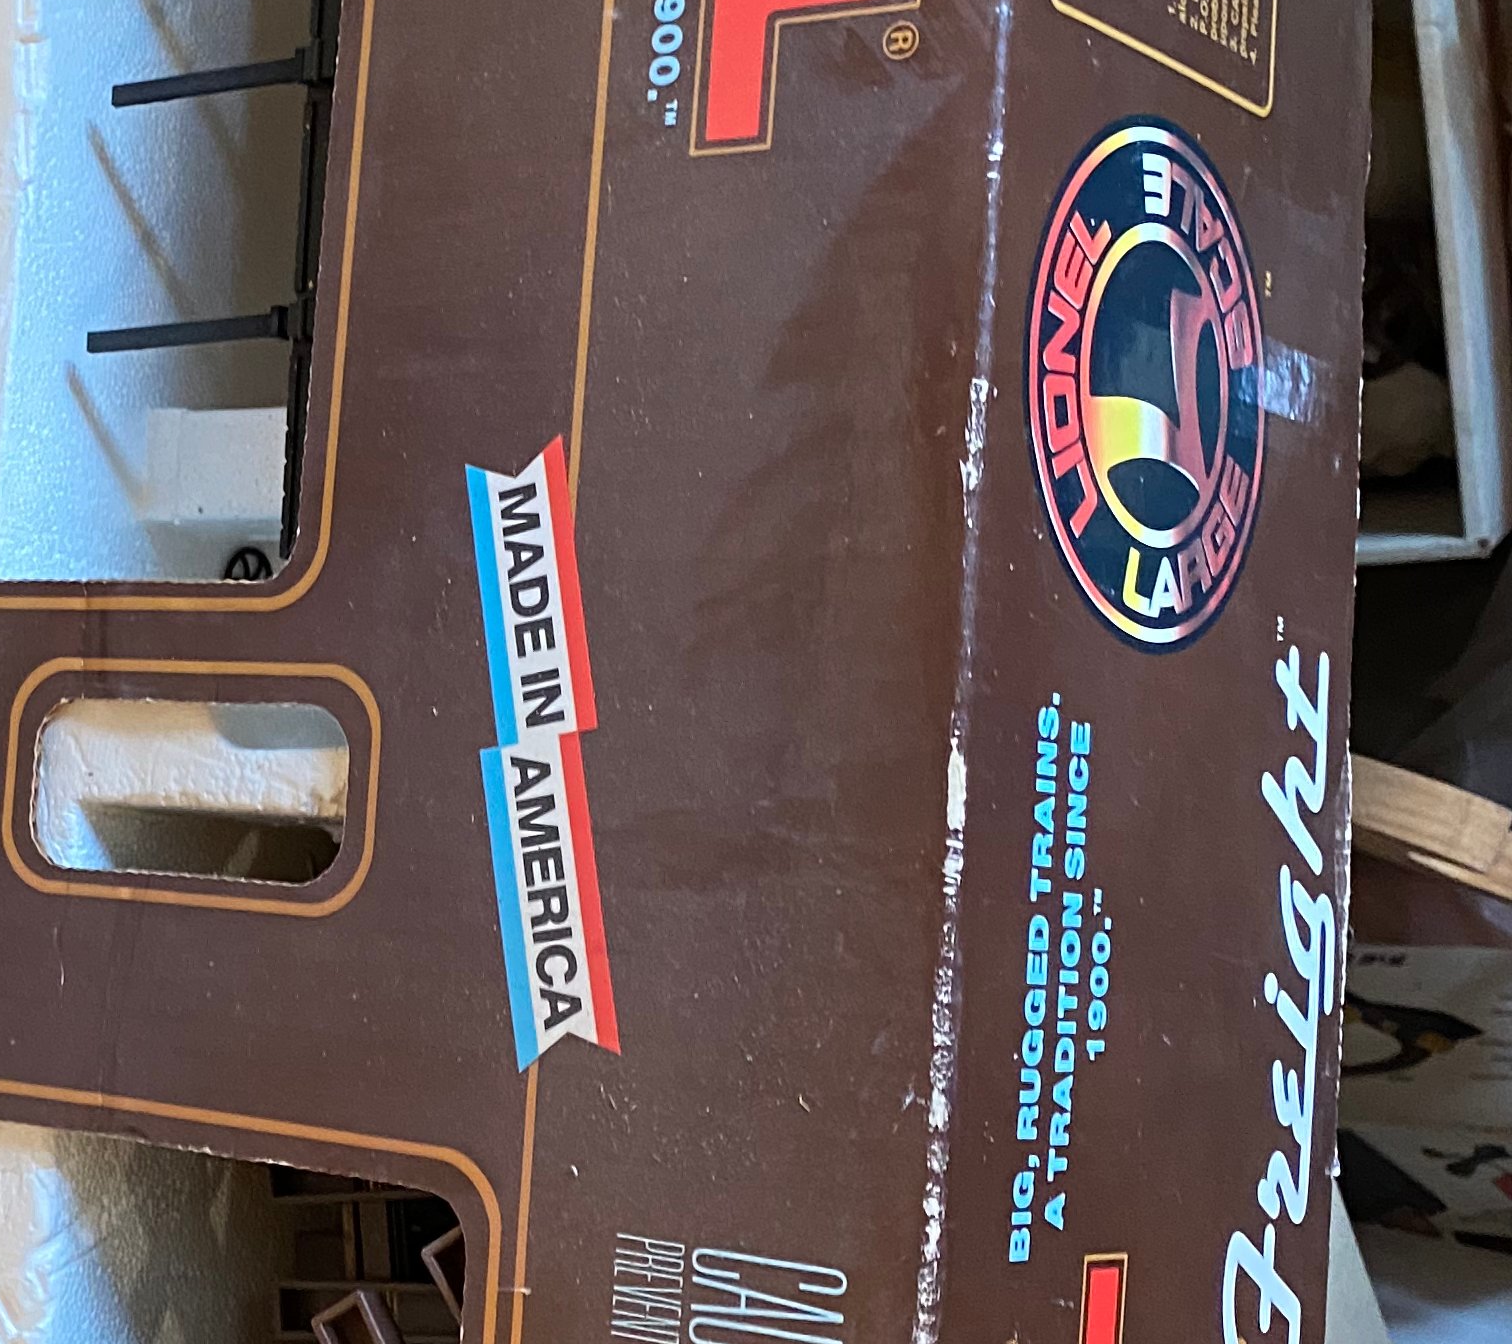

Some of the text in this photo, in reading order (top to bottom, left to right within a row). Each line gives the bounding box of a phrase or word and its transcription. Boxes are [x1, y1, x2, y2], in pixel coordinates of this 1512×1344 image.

[1039, 211, 1112, 539] LIONEL
[1142, 152, 1256, 370] SCALE
[1122, 452, 1250, 618] LARGE
[499, 485, 581, 1030] MADE IN AMERICA
[1009, 694, 1060, 1262] BIG, RUGGED TRAINS.
[1045, 722, 1090, 1230] A TRADITION SINCE
